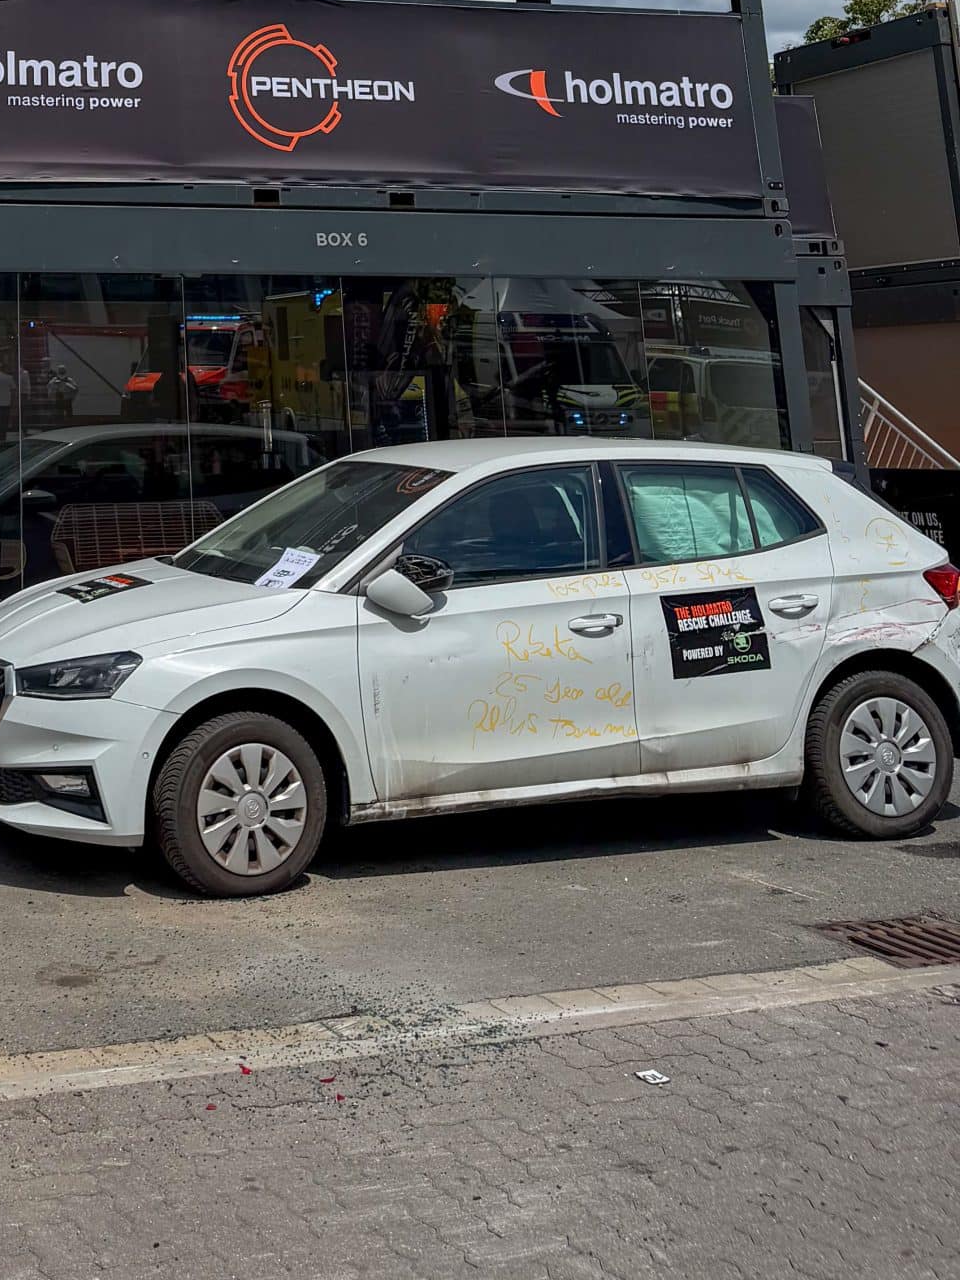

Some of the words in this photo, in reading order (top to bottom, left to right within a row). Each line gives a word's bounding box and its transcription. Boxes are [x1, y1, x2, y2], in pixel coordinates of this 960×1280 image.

[251, 76, 415, 103] PENTHEON
[564, 71, 734, 110] holmatro
[7, 94, 85, 109] mastering
[89, 96, 141, 109] power
[616, 112, 685, 129] mastering
[689, 116, 734, 129] power
[316, 233, 354, 247] BOX
[357, 233, 368, 247] 6
[911, 511, 925, 526] ON
[674, 607, 691, 619] THE
[691, 601, 733, 618] HOLMATRO
[677, 617, 708, 632] RESCUE
[708, 609, 753, 627] CHALLENGE
[682, 646, 714, 661] POWERED
[715, 645, 724, 657] BY
